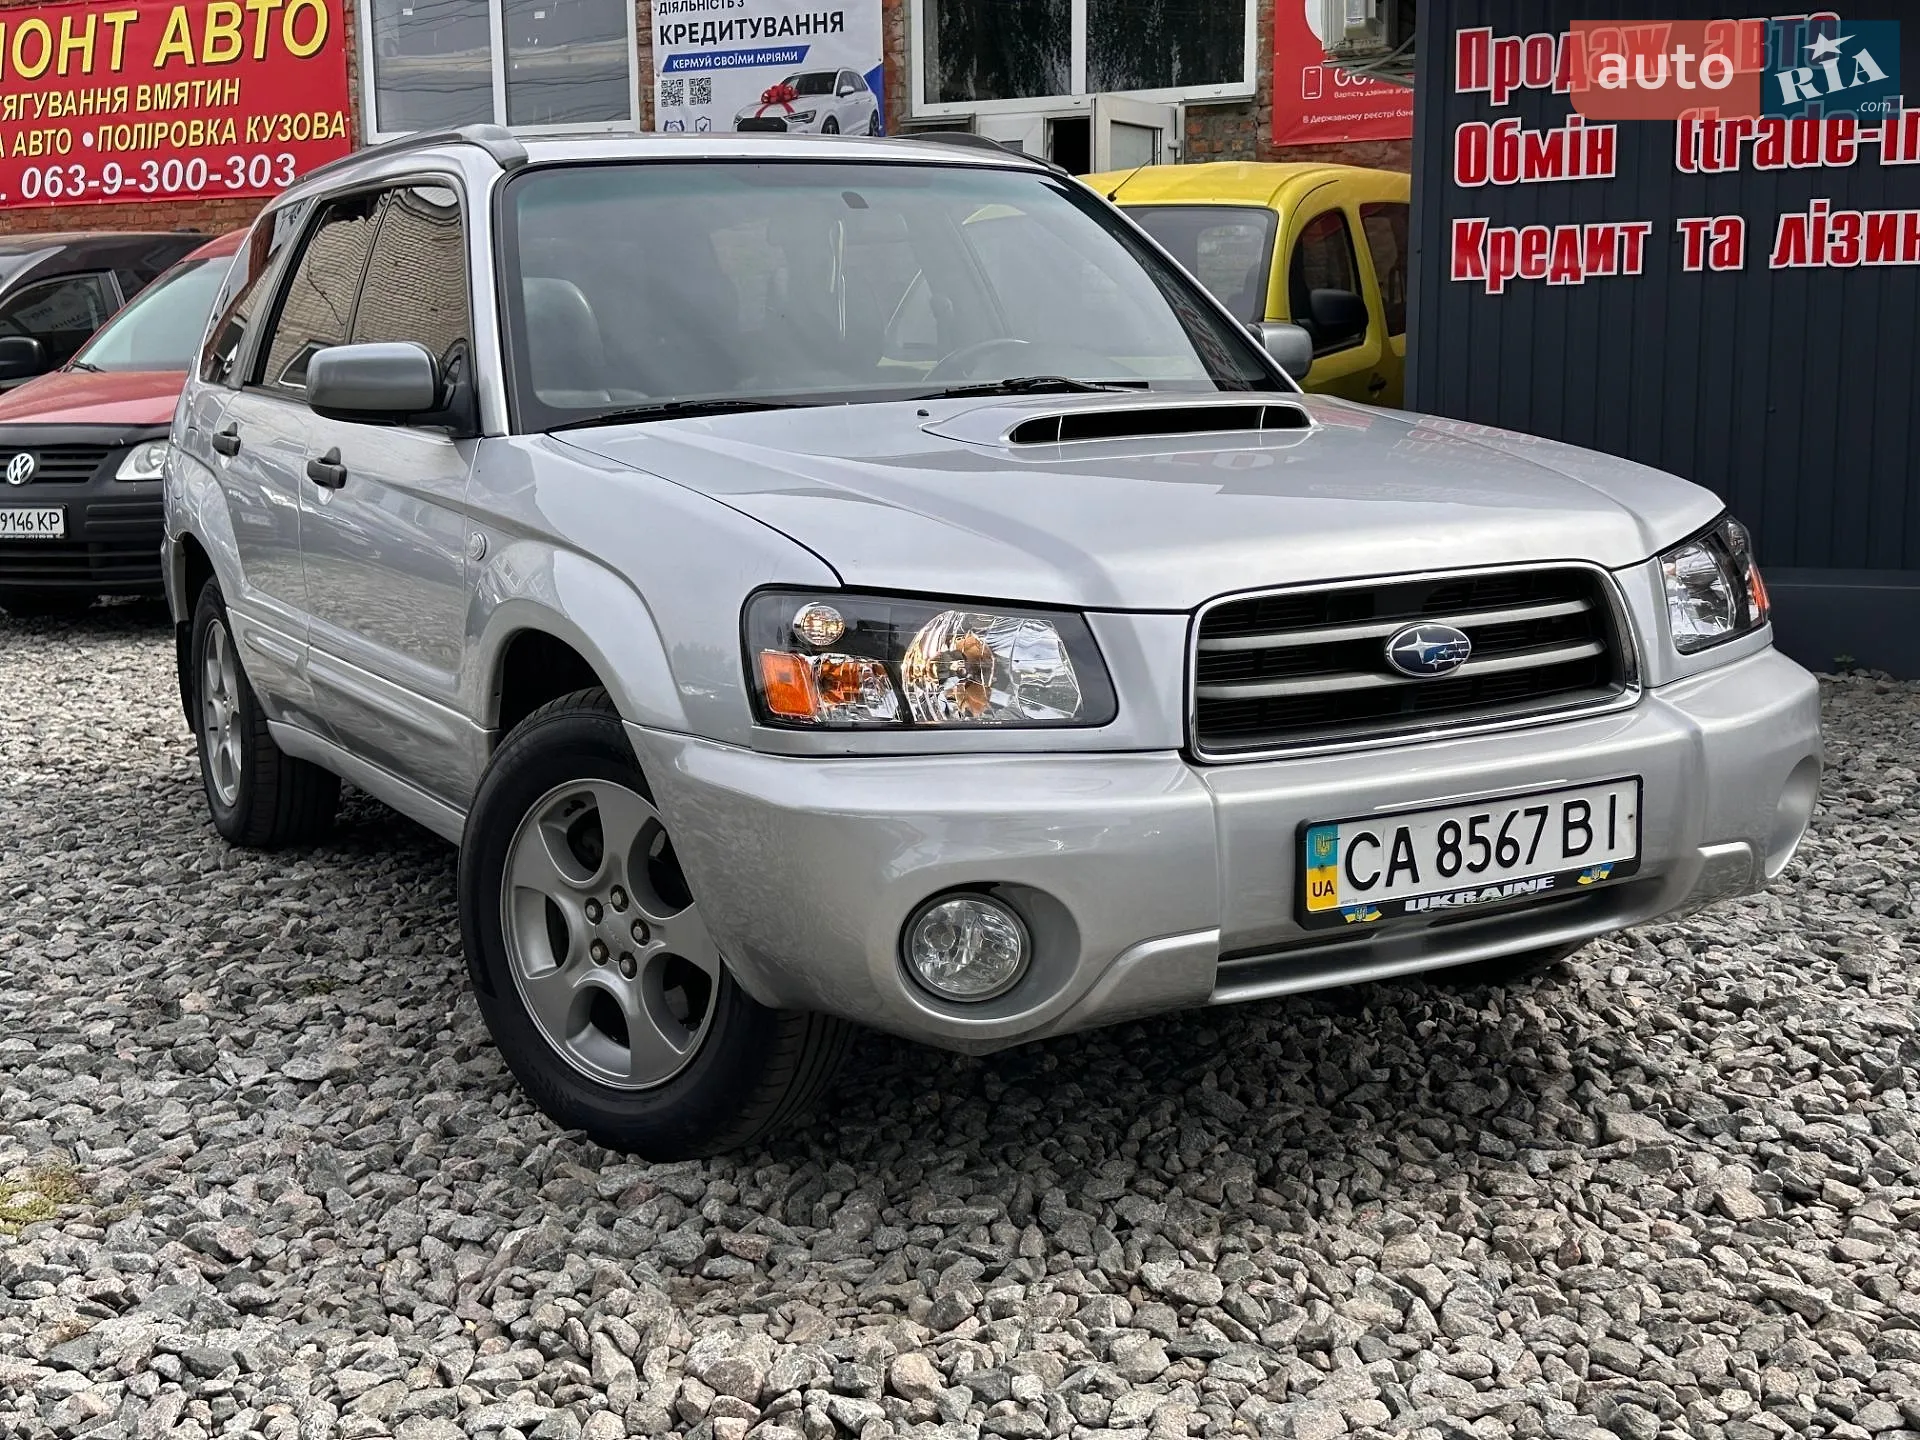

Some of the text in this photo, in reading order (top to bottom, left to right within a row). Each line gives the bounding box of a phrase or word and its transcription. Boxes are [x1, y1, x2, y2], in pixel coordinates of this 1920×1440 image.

[0, 0, 328, 80] ОНТ АВТО
[660, 11, 844, 46] КРЕДИТУВАННЯ
[672, 51, 798, 69] КЕРМУЙ СВОЇМИ МРІЯМИ
[1455, 22, 1672, 106] Продаж
[0, 78, 240, 121] ЯГУВАННЯ ВМЯТИН
[12, 128, 72, 158] АВТО
[246, 111, 346, 144] КУЗОВА
[1453, 113, 1617, 188] Обмін
[21, 153, 296, 199] 063-9-300-303
[1451, 217, 1652, 294] Кредит
[1676, 215, 1745, 271] та
[0, 511, 60, 532] 9146 KP
[1345, 794, 1617, 891] CA 8567 BI
[1312, 882, 1335, 897] UA
[1405, 876, 1555, 911] UKRAINE
